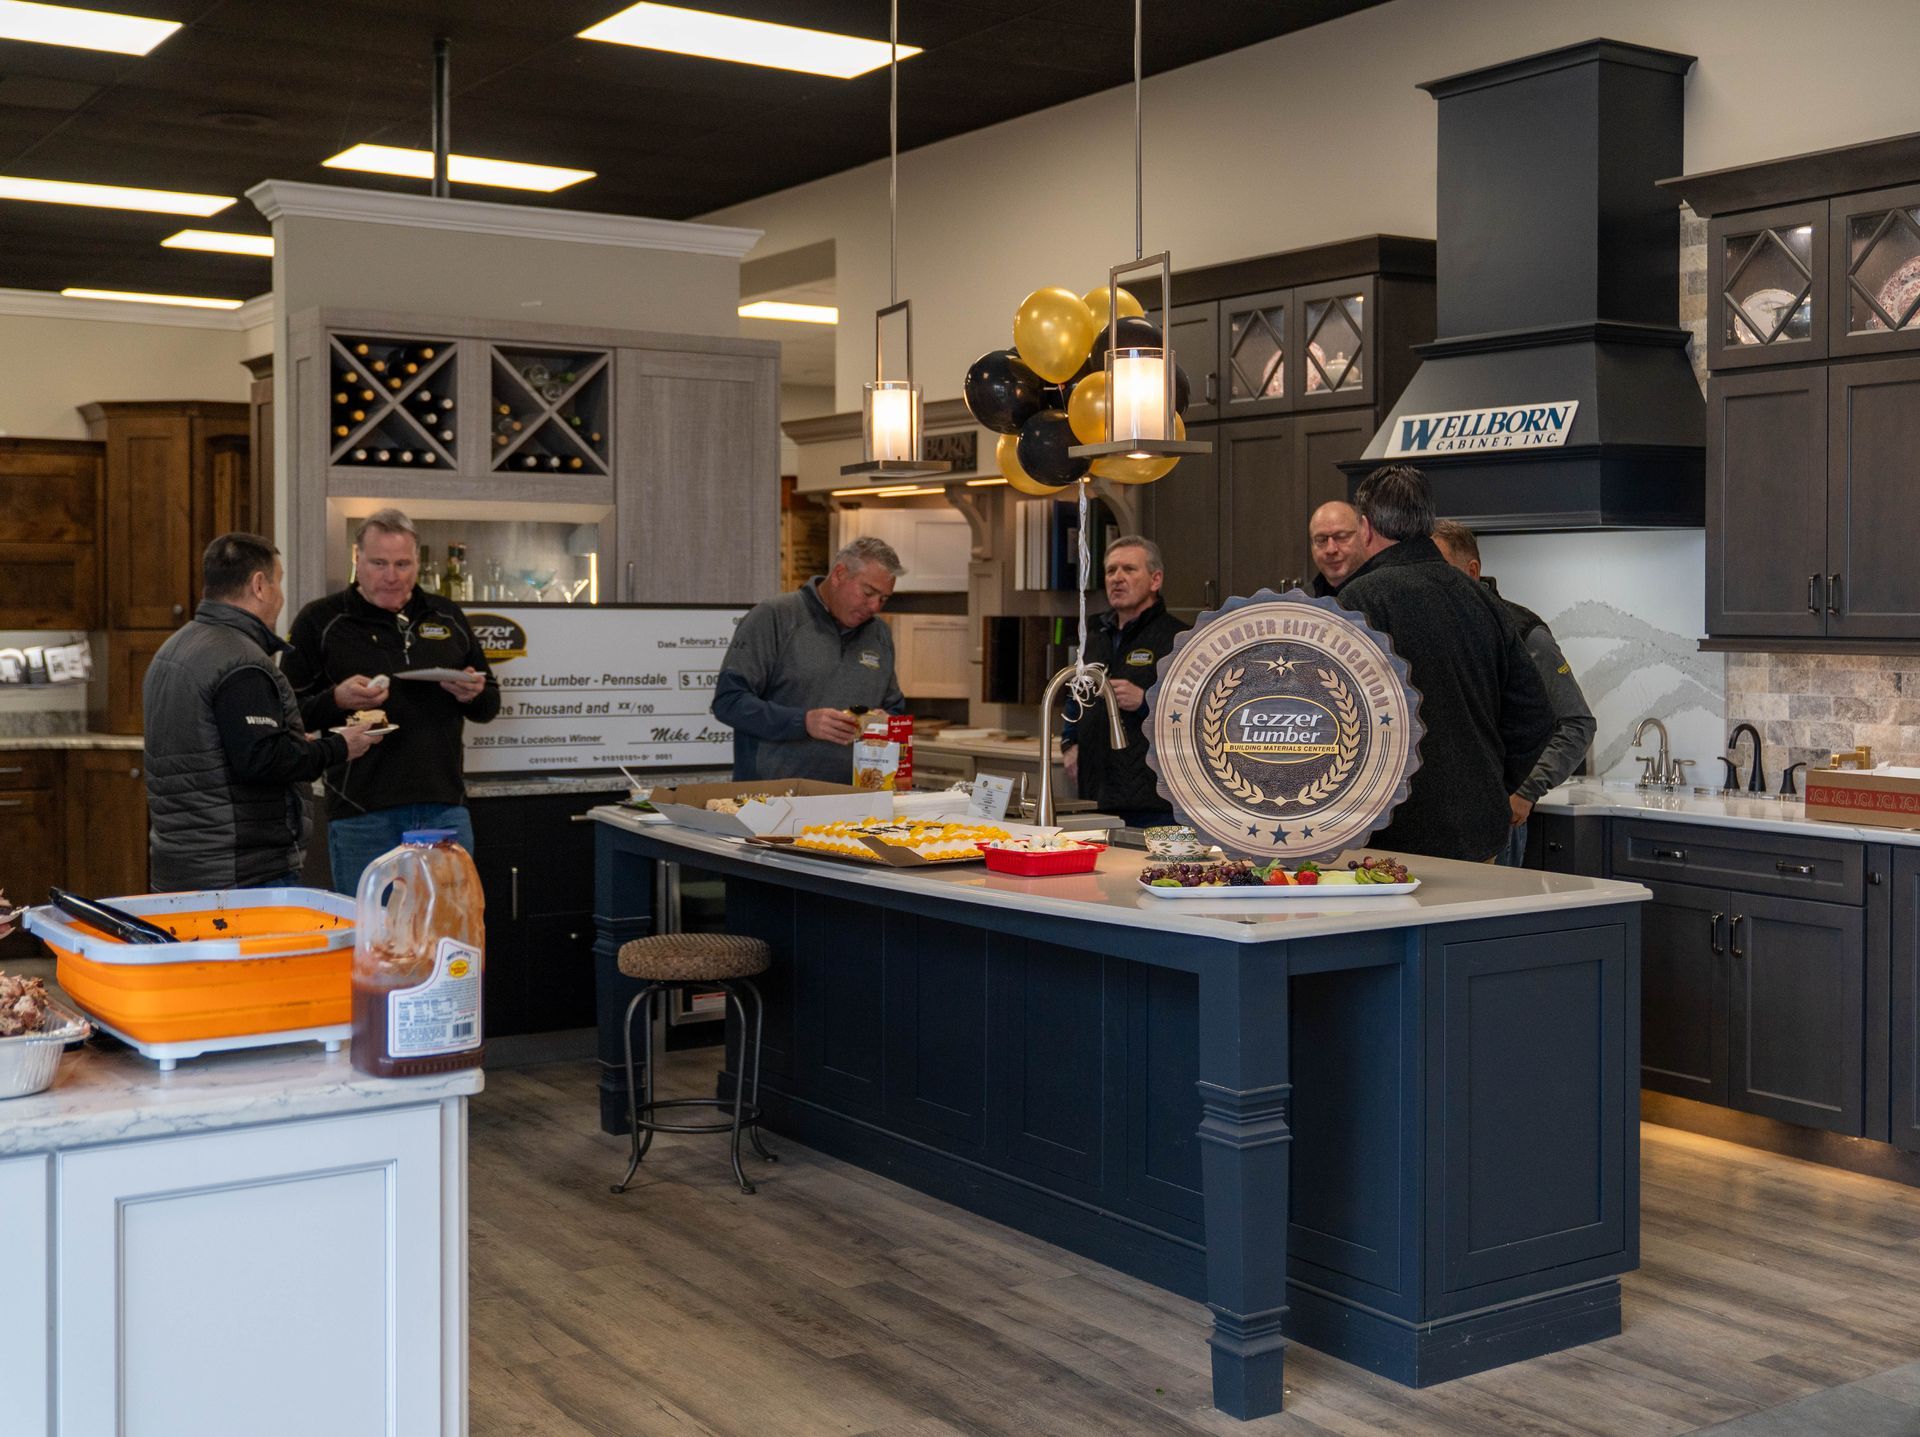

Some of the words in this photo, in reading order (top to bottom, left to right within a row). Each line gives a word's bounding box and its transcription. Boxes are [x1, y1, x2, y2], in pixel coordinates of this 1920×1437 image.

[1401, 406, 1572, 451] WELLBORN
[1436, 437, 1512, 451] CABINET,
[1523, 433, 1558, 446] INC.
[471, 625, 515, 638] zzer
[479, 635, 514, 650] ber
[657, 641, 677, 649] Date
[680, 637, 717, 648] February
[1174, 652, 1213, 707] LEZZER
[1210, 619, 1277, 656] LUMBER
[1283, 619, 1329, 643] ELITE
[1329, 635, 1389, 709] LOCATION
[541, 675, 591, 687] Lumber
[602, 673, 667, 686] Pennsdale
[682, 674, 690, 687] $
[696, 675, 719, 688] 1,00
[500, 705, 514, 715] ne
[518, 702, 583, 715] Thousand
[586, 702, 610, 714] and
[1240, 708, 1322, 727] Lezzer
[473, 736, 496, 746] 2025
[498, 735, 519, 745] Elite
[521, 734, 567, 745] Locations
[569, 734, 602, 743] Winner
[650, 726, 690, 741] Mike
[696, 726, 734, 744] Lezze
[1242, 726, 1320, 743] Lumber
[1303, 745, 1336, 753] CENTERS
